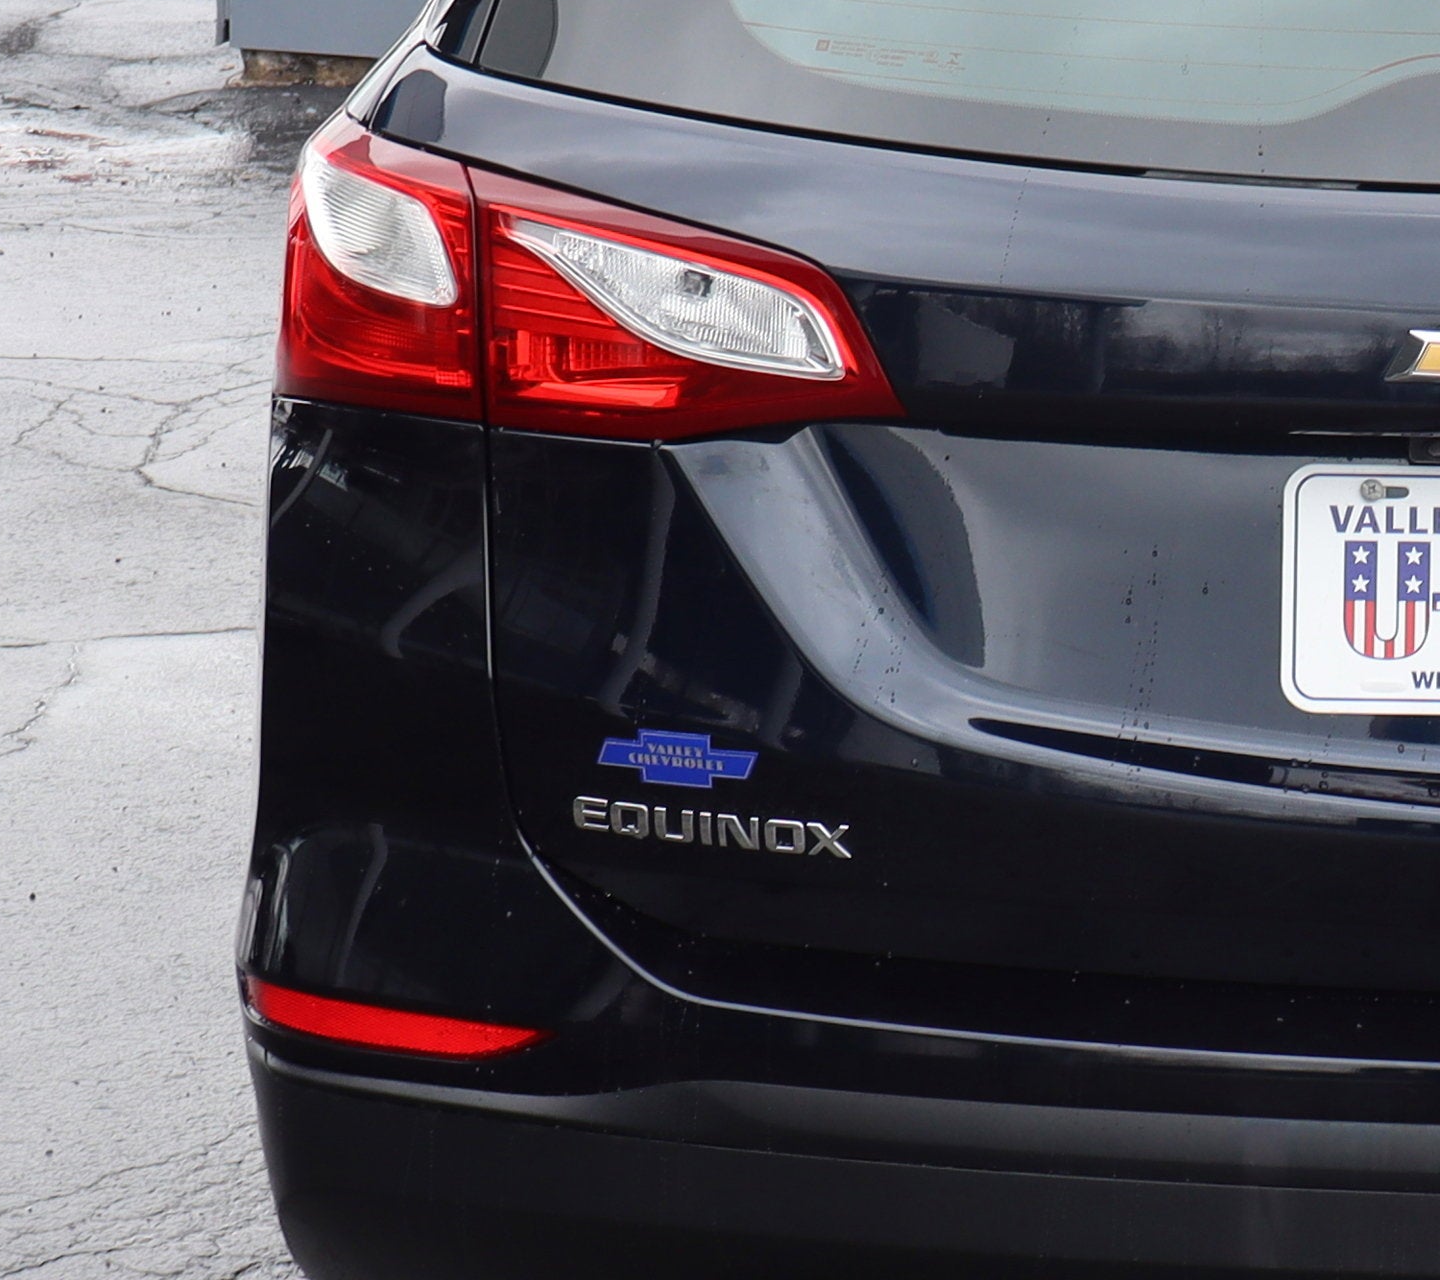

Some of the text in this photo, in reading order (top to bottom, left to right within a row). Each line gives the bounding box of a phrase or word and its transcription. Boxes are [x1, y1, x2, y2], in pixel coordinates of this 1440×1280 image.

[628, 742, 725, 771] VALLEY CHEVROLET
[573, 795, 852, 859] EQUINOX
